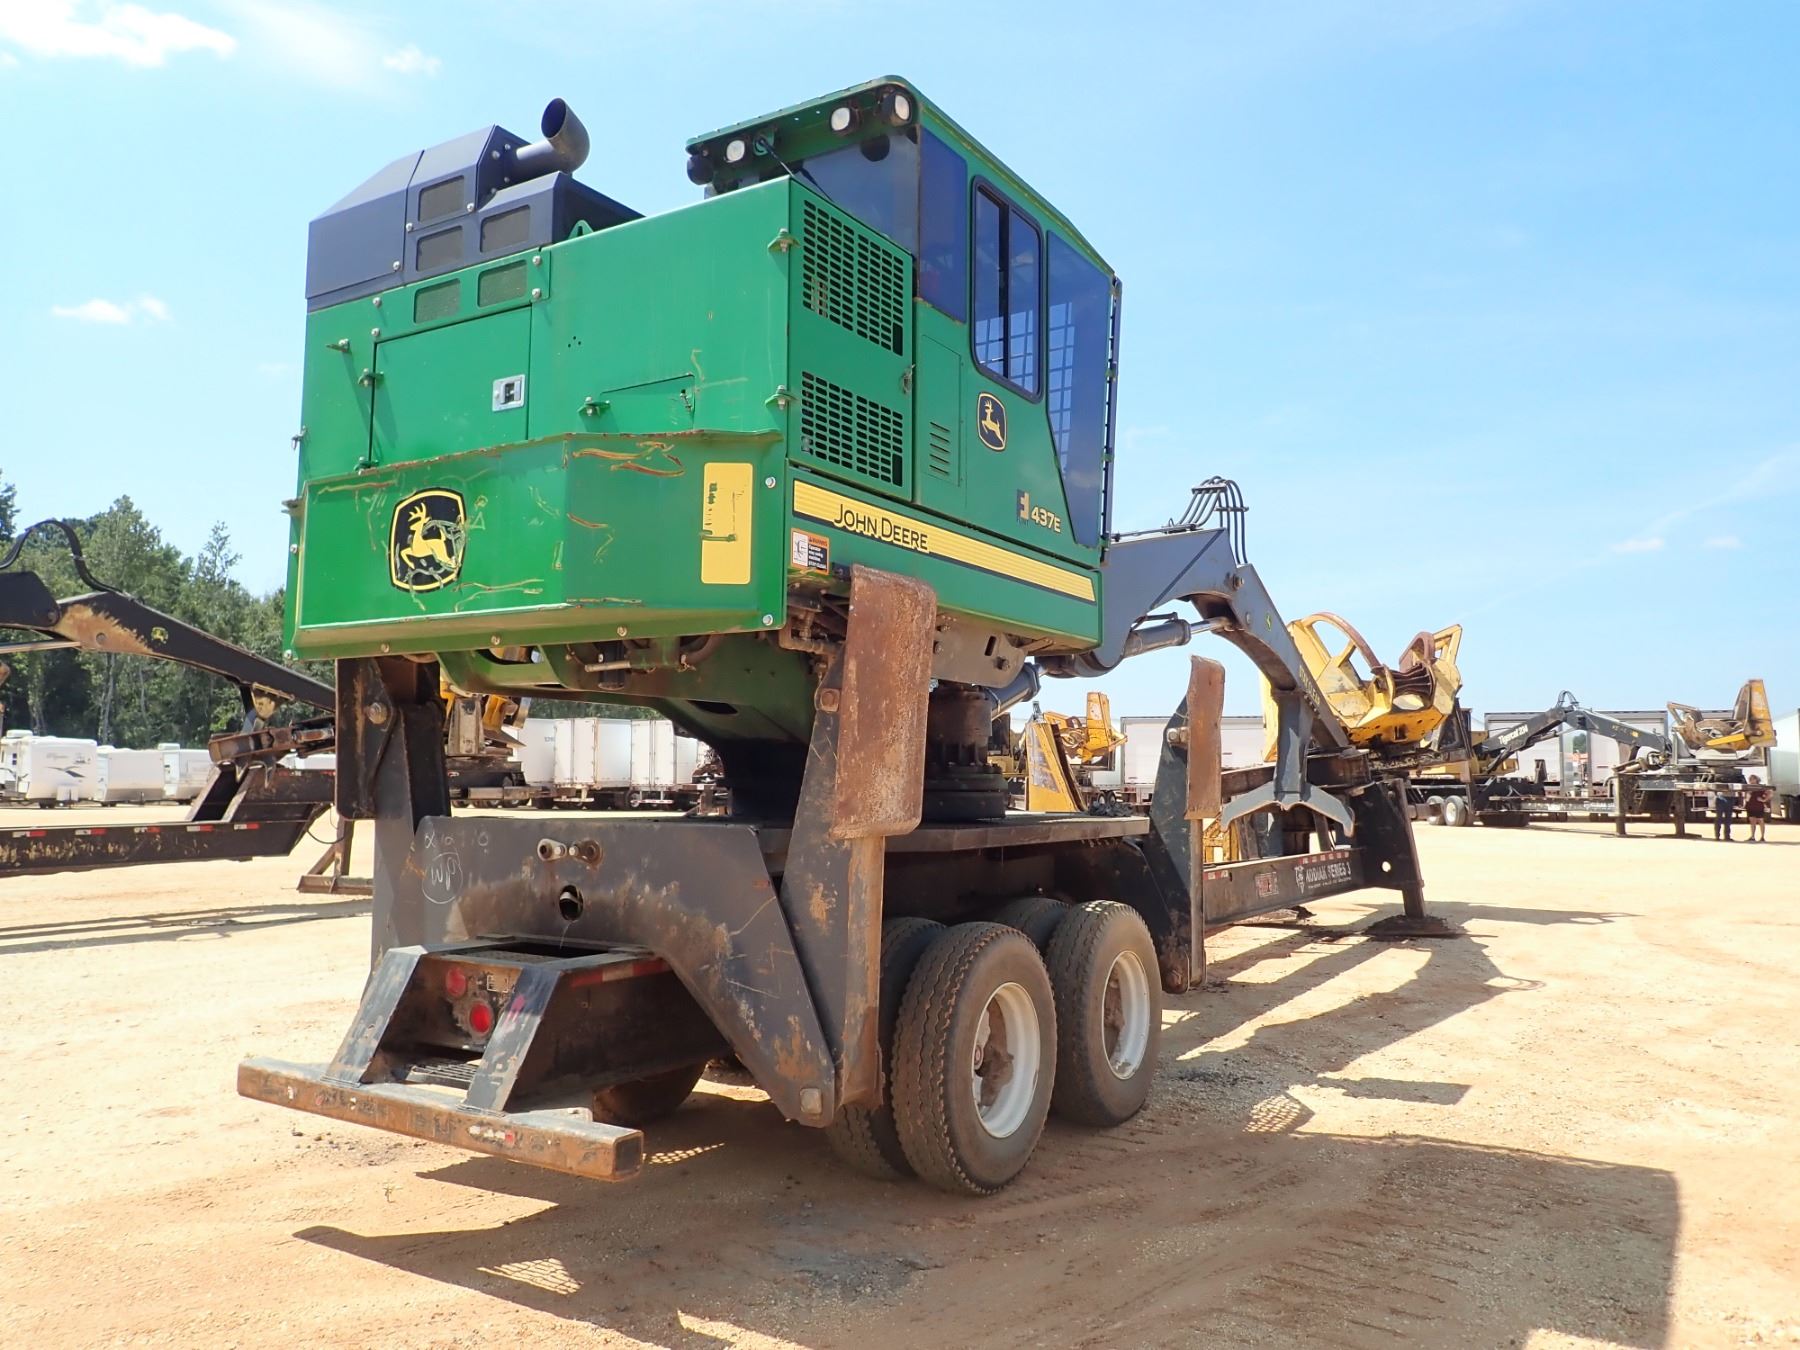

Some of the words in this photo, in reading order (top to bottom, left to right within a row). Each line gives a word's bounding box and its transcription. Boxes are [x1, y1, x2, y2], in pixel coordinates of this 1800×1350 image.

[834, 504, 877, 535] JOHN
[881, 517, 928, 550] DEERE
[1031, 506, 1061, 533] 437E
